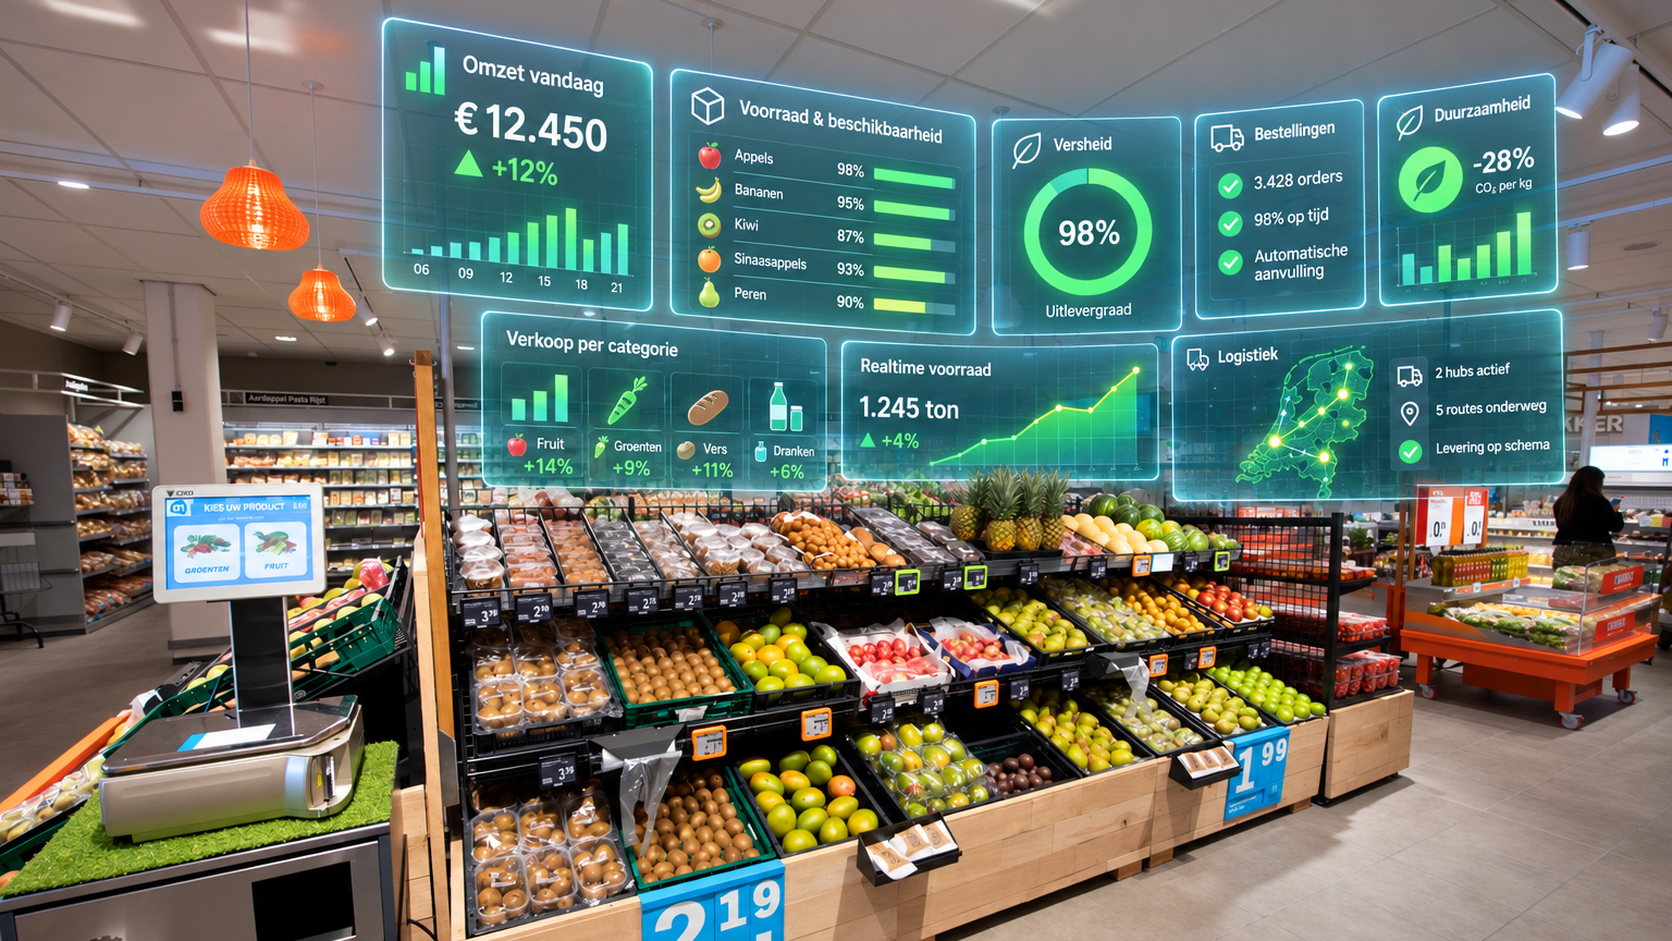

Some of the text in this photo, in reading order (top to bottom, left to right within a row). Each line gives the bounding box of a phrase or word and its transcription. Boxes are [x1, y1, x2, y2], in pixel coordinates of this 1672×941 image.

[204, 503, 225, 513] KIES
[226, 502, 242, 512] UW
[243, 502, 285, 512] PRODUCT
[184, 565, 230, 575] GROENTEN
[264, 562, 289, 570] FRUIT
